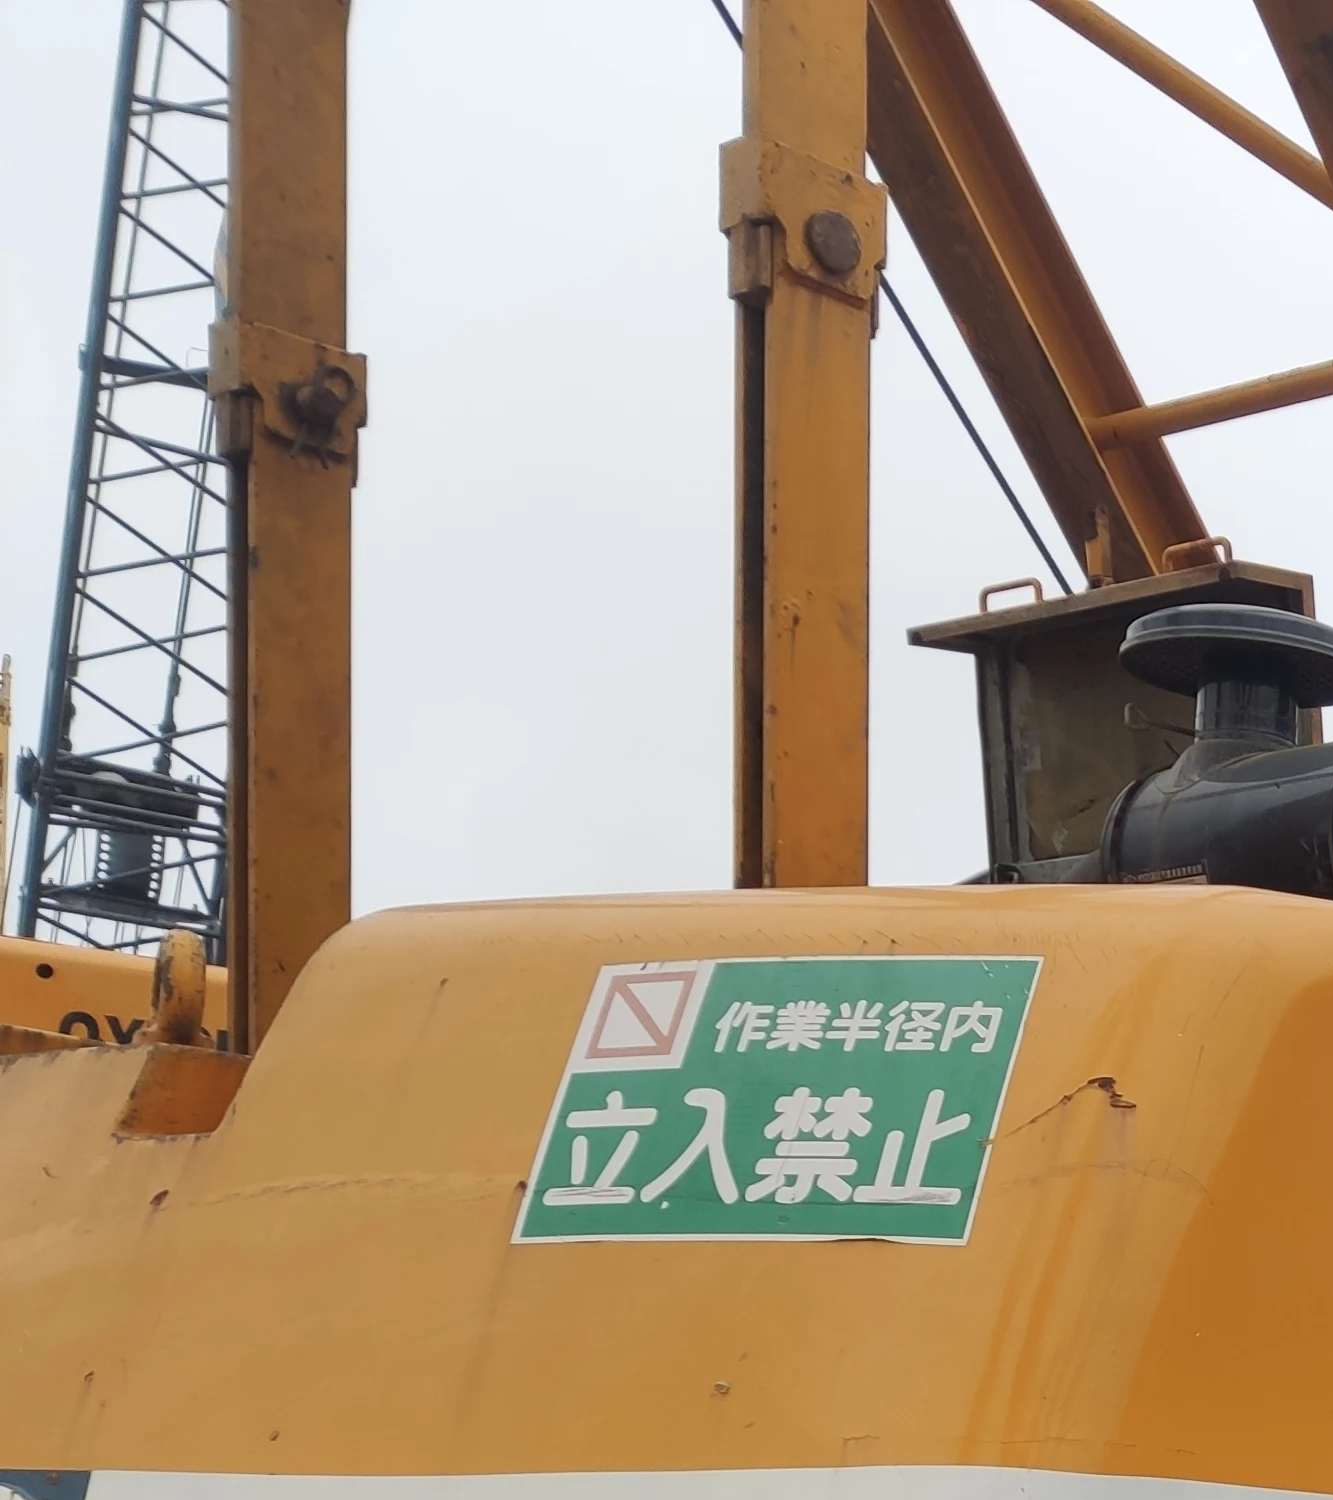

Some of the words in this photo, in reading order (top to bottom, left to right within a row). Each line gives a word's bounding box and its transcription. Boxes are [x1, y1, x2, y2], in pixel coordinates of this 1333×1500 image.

[713, 999, 1003, 1054] 作業半径内
[542, 1086, 971, 1206] 立入禁止
